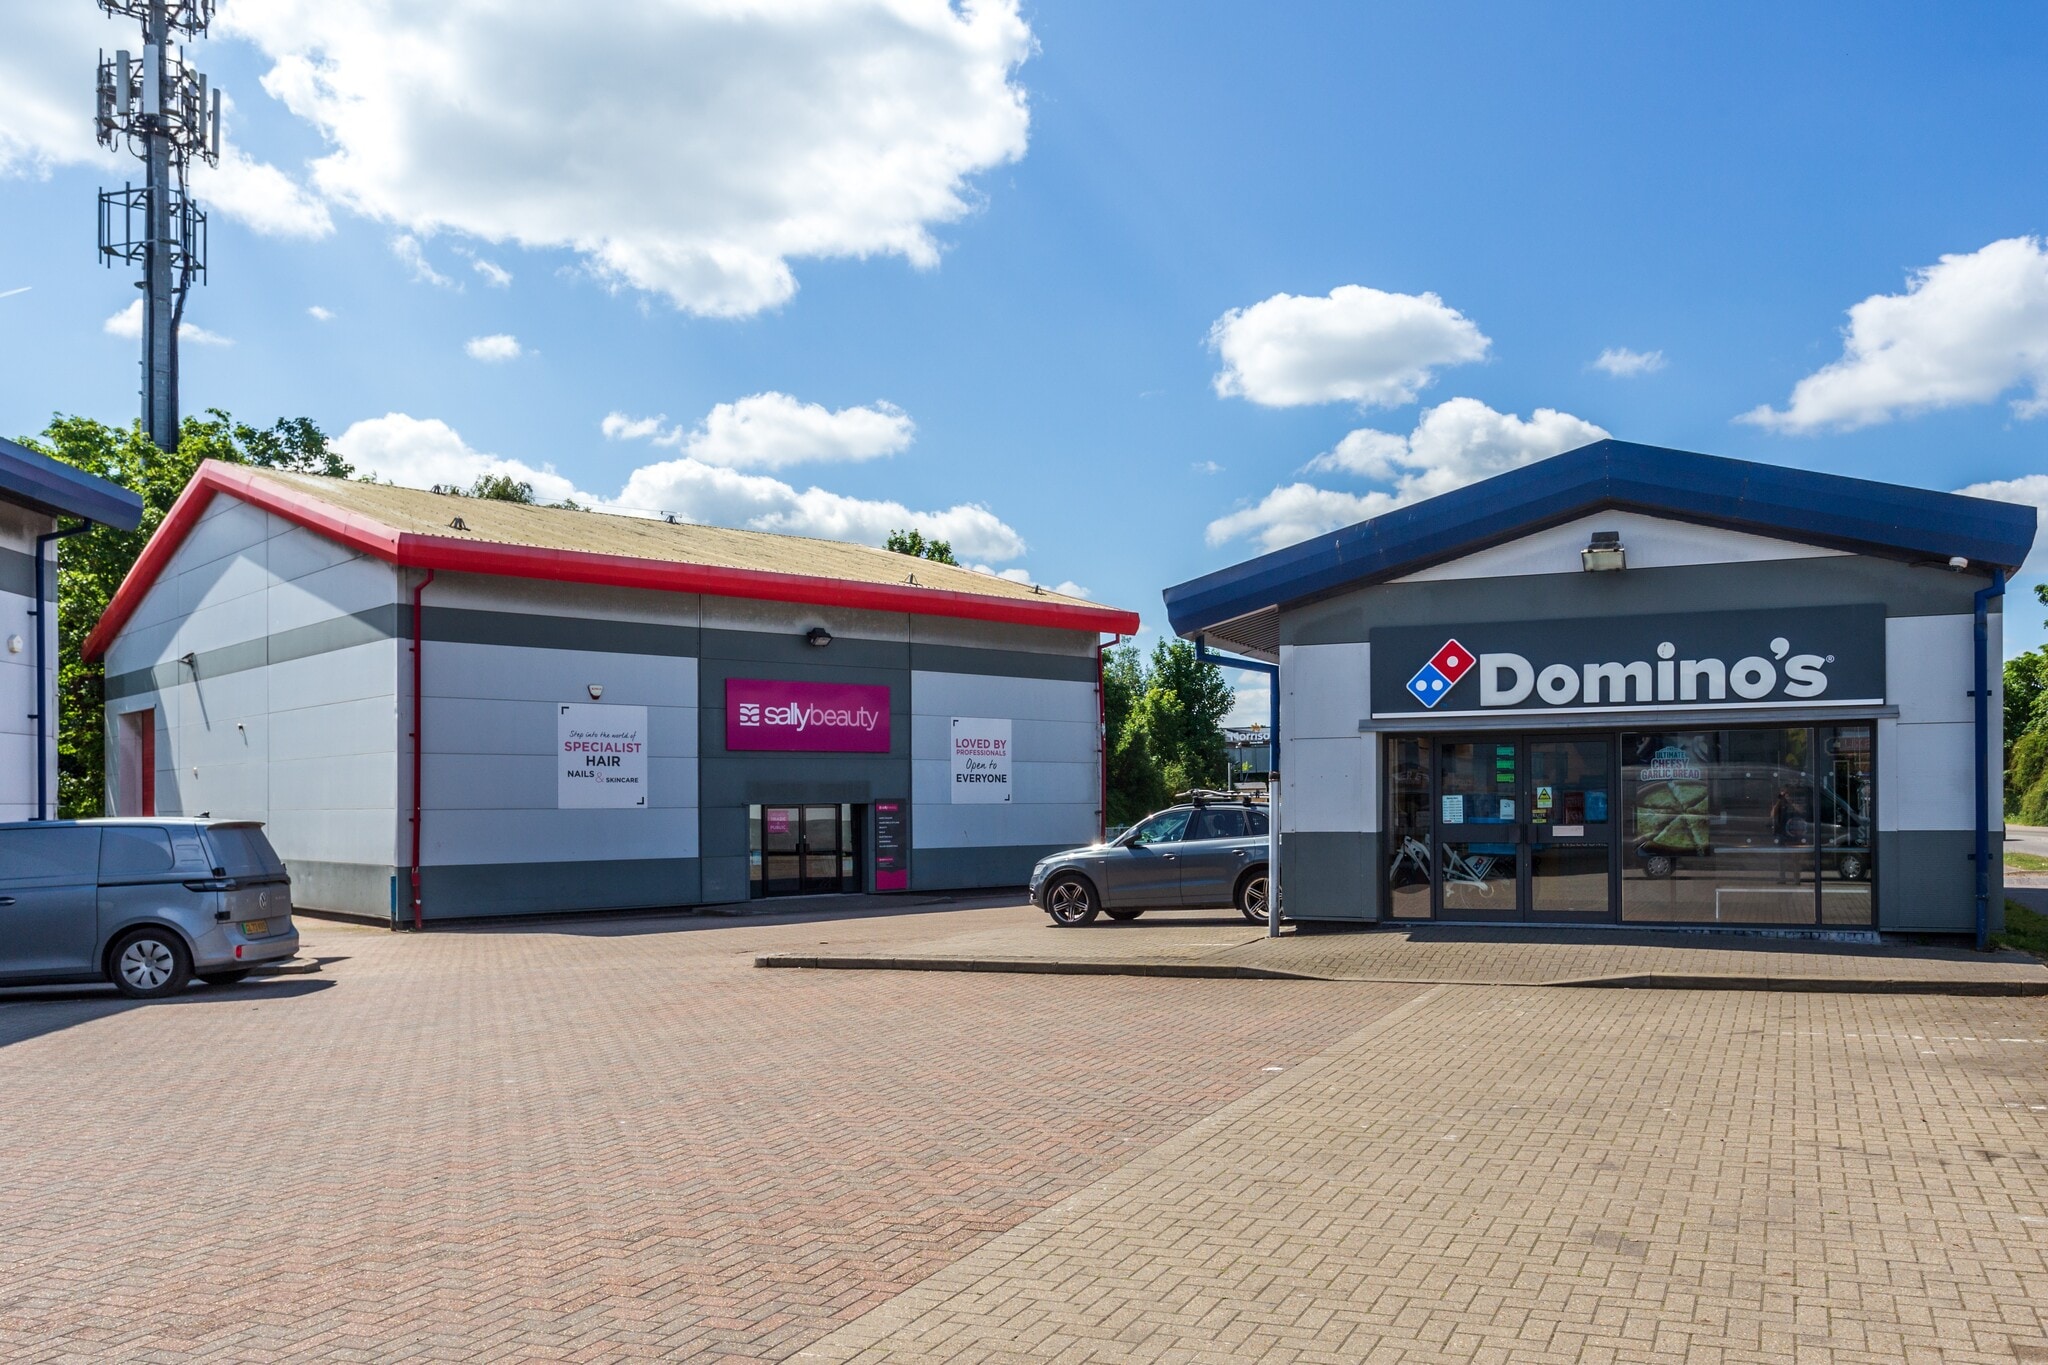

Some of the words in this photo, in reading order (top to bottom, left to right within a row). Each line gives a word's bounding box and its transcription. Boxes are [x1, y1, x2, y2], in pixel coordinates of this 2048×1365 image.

[569, 730, 583, 740] Step
[600, 731, 610, 739] the
[629, 730, 637, 741] of
[564, 741, 642, 753] SPECIALIST
[956, 738, 991, 749] LOVED
[993, 739, 1007, 749] BY
[956, 749, 1006, 757] PROFESSIONALS
[1656, 751, 1686, 759] ULTIMATE
[586, 755, 621, 767] HAIR
[965, 757, 986, 773] Open
[988, 759, 997, 770] to
[1652, 758, 1689, 769] CHEESY
[567, 770, 595, 778] NAILS
[595, 771, 604, 783] &
[956, 773, 1008, 783] EVERYONE
[1641, 769, 1671, 780] GARLIC
[1673, 768, 1700, 779] BREAD
